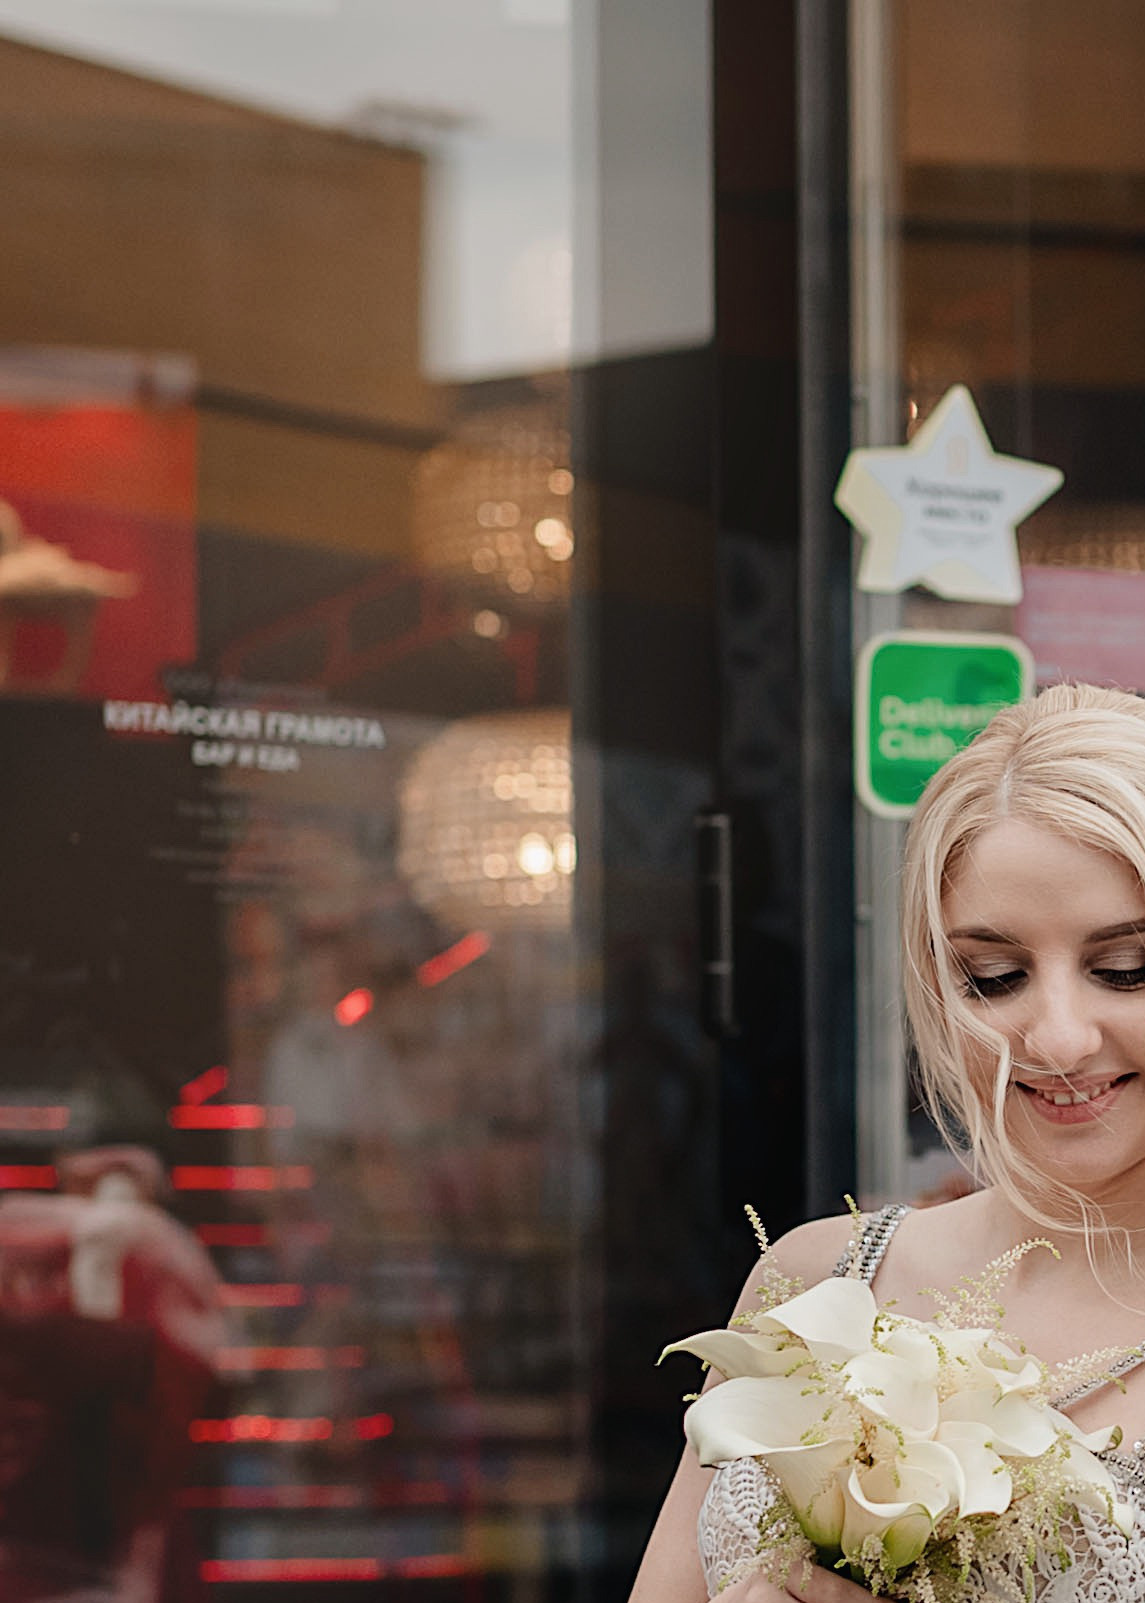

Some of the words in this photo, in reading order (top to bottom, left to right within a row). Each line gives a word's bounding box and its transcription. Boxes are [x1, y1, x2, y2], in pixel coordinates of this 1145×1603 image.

[104, 700, 261, 738] КИТАЙСКАЯ
[266, 711, 387, 749] ГРАМОТА
[879, 730, 956, 761] Club
